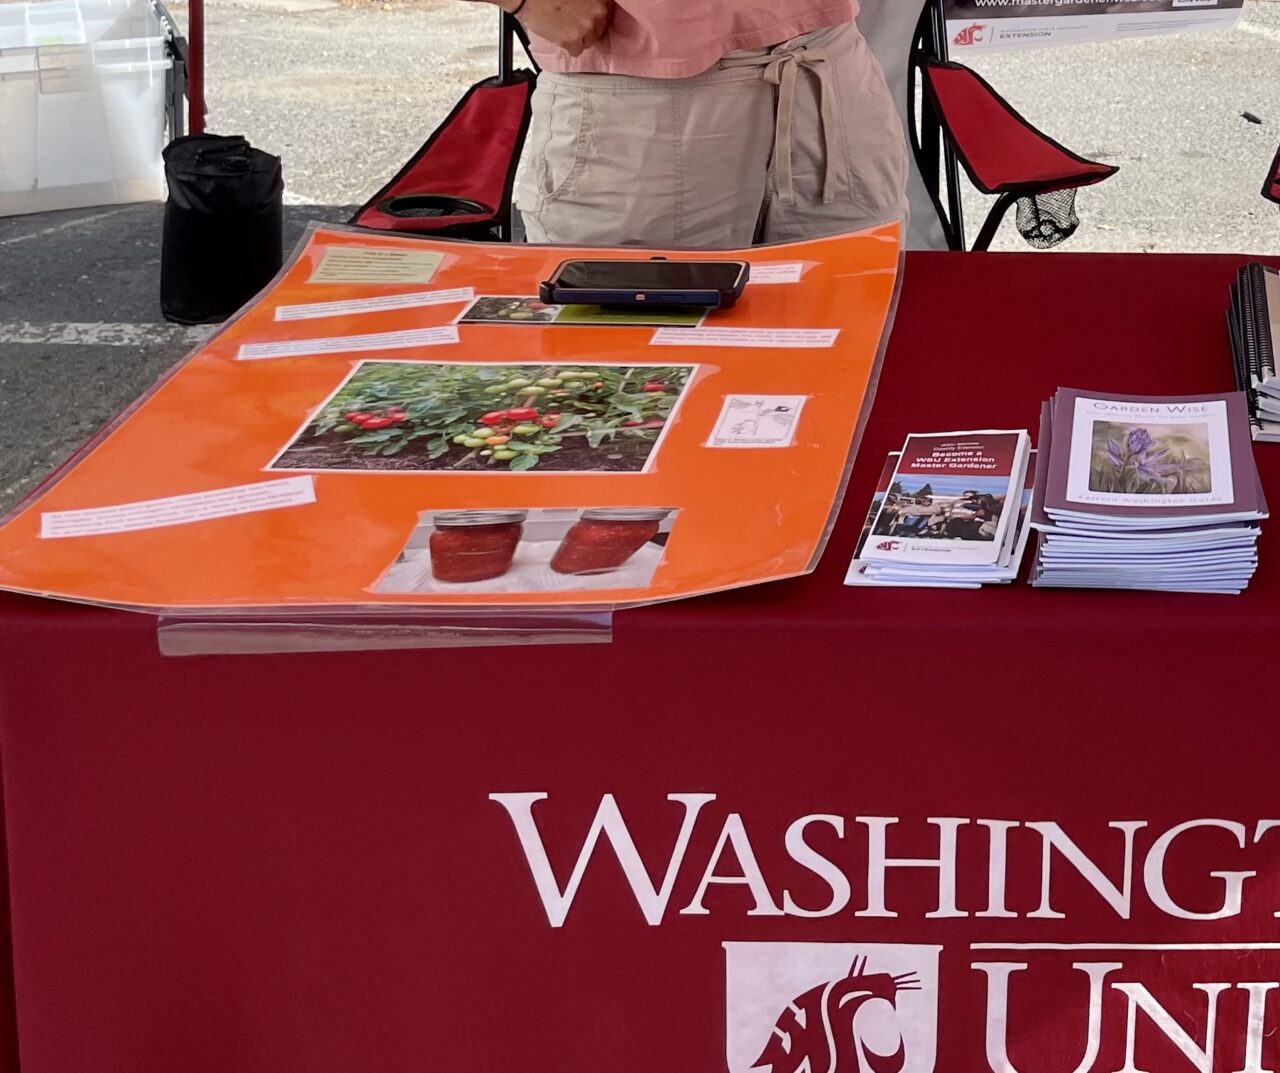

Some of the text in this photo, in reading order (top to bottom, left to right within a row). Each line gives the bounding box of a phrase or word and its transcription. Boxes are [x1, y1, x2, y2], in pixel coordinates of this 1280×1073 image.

[999, 31, 1052, 39] EXTENSION
[1093, 402, 1208, 413] GARDEN WISE
